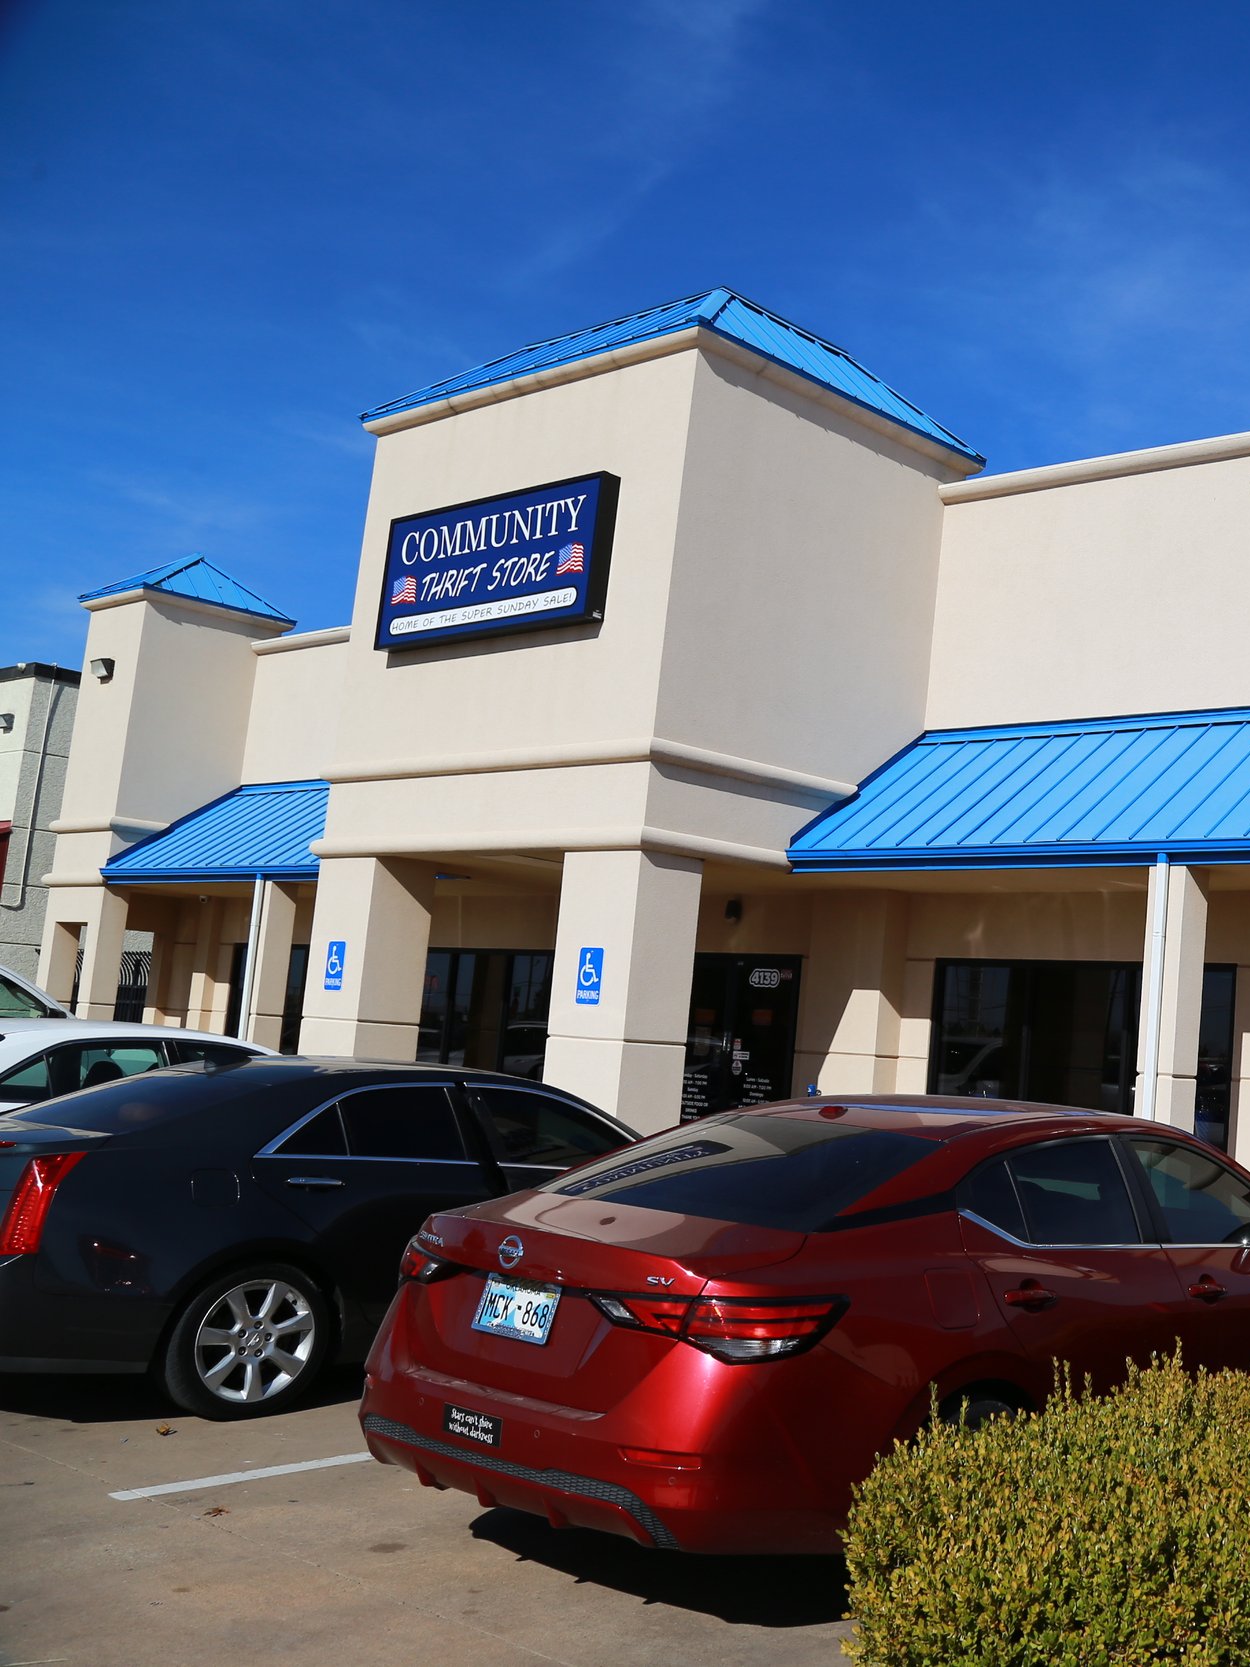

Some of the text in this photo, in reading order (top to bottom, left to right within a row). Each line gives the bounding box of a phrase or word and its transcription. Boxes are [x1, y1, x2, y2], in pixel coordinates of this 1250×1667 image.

[401, 495, 587, 565] COMMUNITY
[420, 551, 555, 602] THRIFT STORE
[391, 592, 573, 632] HOME OF THE SUPER SUNDAY SALE!
[751, 971, 778, 985] 4139
[577, 989, 599, 1000] PARKING
[646, 1276, 675, 1287] SV
[451, 1408, 465, 1423] Stars
[478, 1415, 493, 1430] shine
[449, 1422, 494, 1444] without darkness
